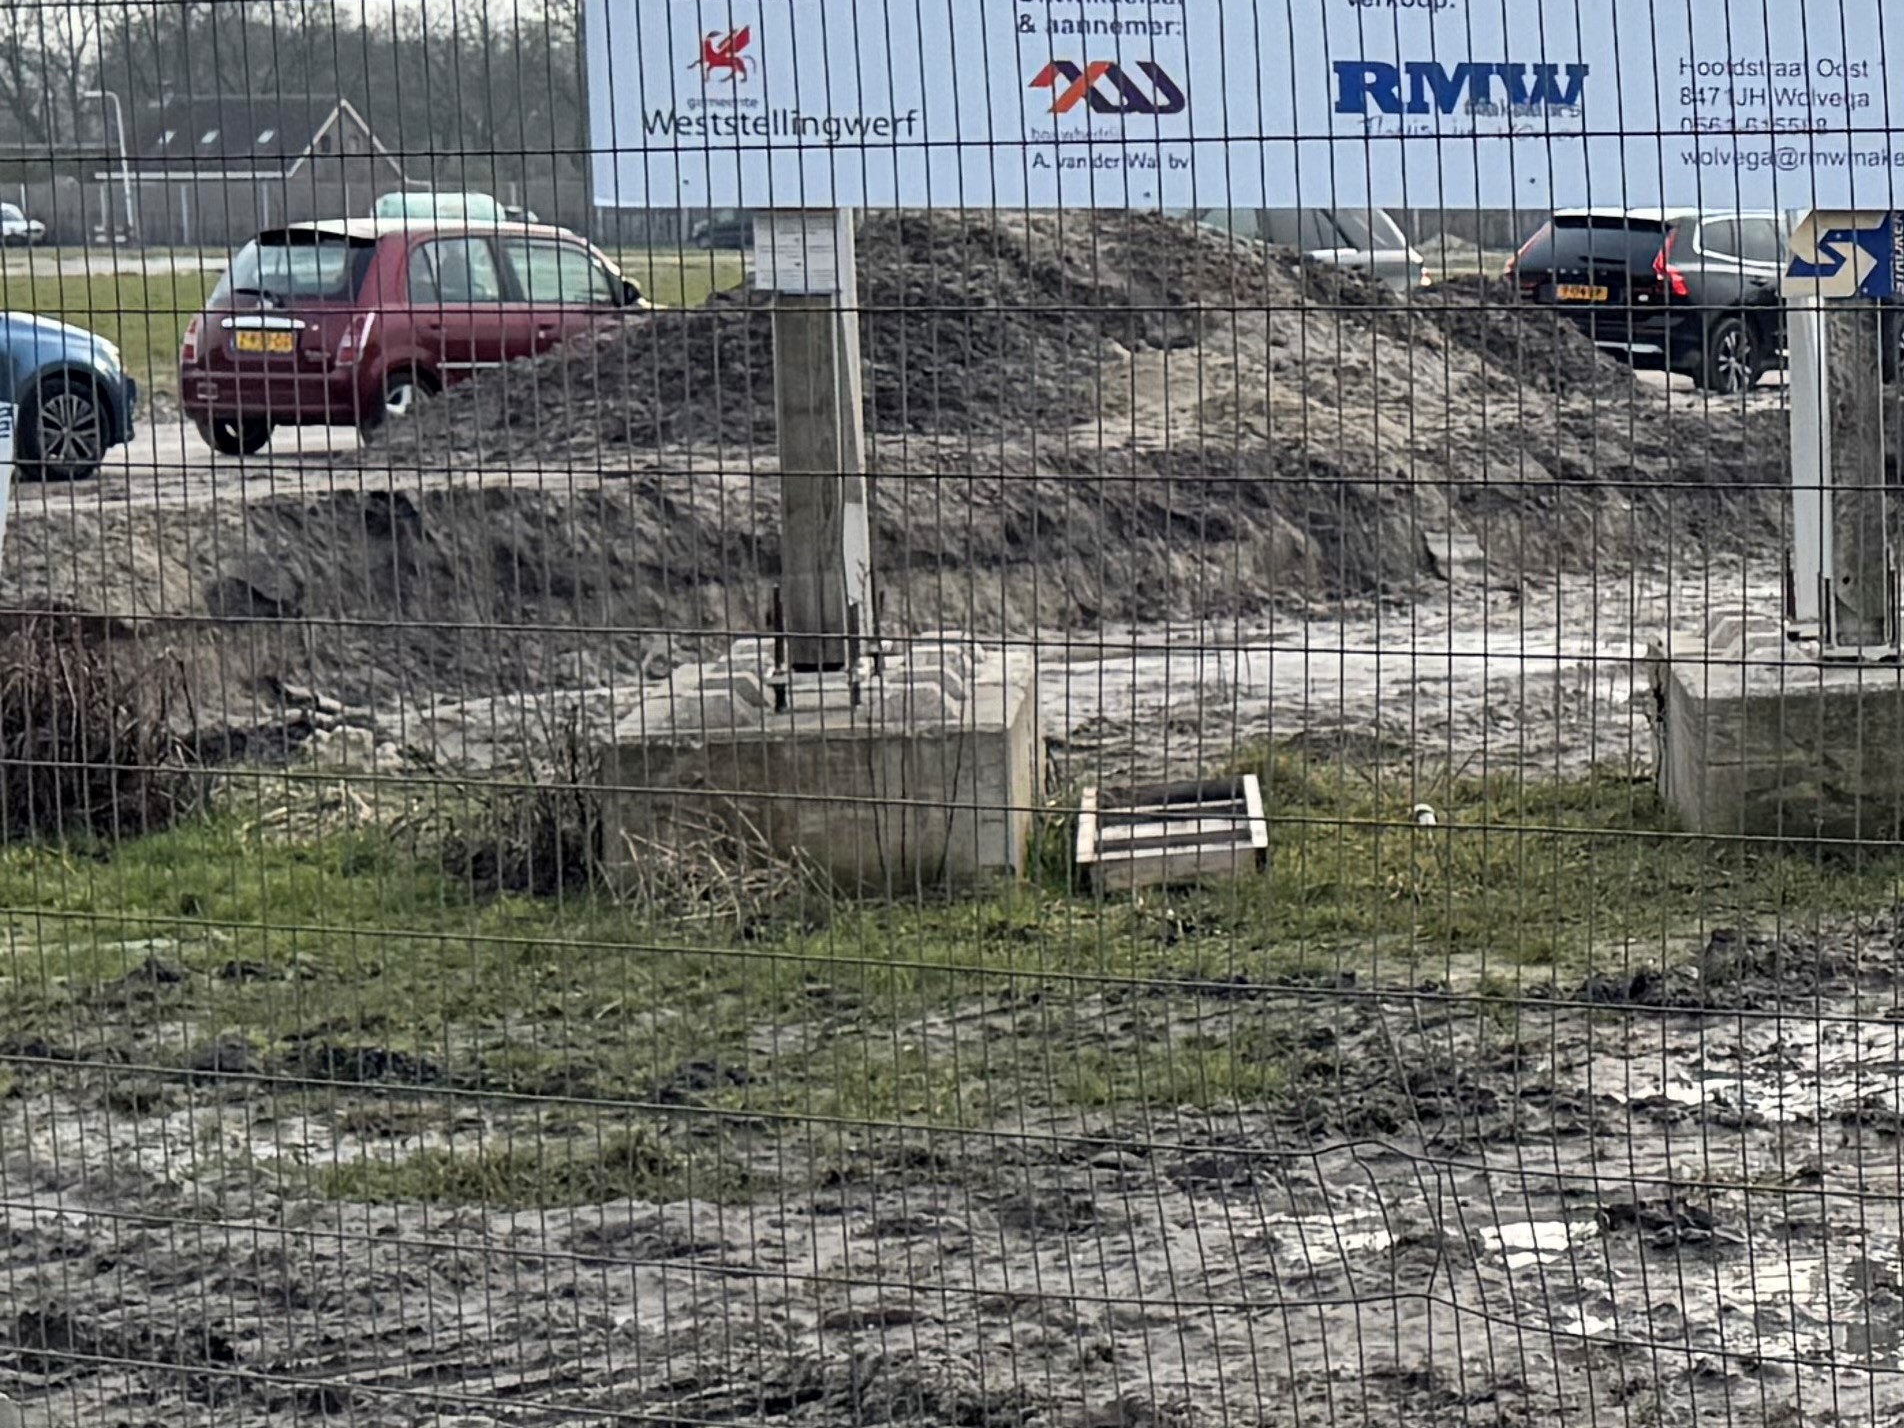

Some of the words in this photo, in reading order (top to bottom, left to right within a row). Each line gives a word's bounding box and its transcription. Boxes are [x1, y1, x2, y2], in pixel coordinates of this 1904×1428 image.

[1018, 13, 1037, 34] &
[1046, 17, 1182, 36] aannemer:
[1679, 57, 1810, 77] Hoodstraa
[1332, 60, 1590, 115] RMW
[641, 108, 919, 143] Weststellingwerf
[1125, 152, 1161, 170] Wa
